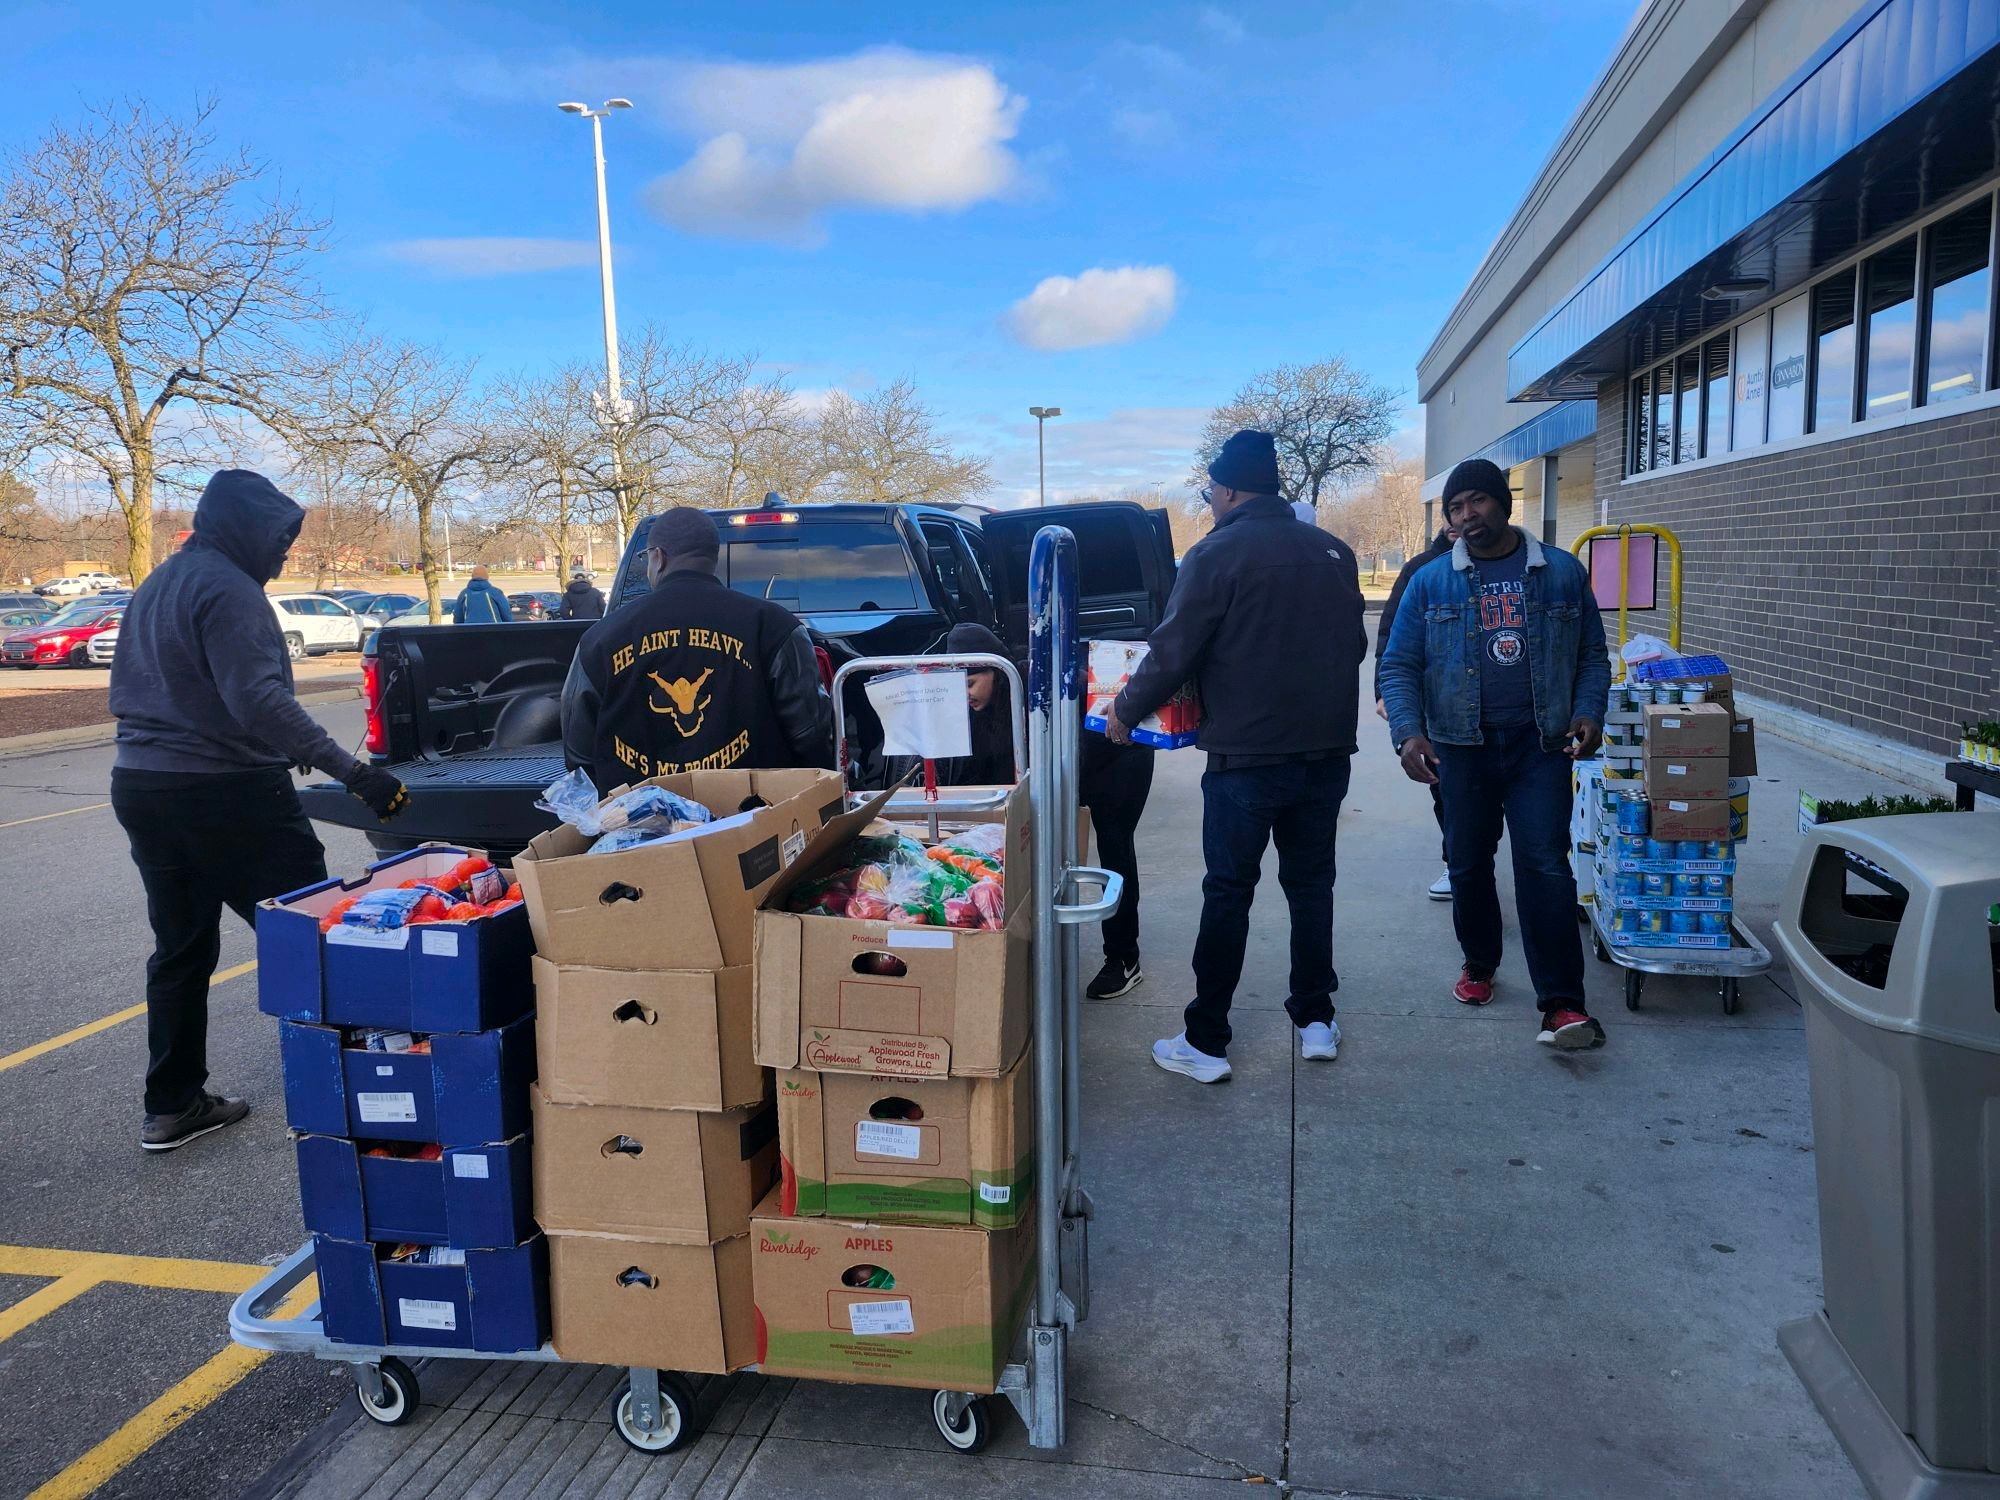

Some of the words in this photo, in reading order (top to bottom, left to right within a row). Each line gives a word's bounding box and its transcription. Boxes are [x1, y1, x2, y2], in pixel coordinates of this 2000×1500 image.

[1481, 581, 1523, 596] ETRO
[1481, 592, 1524, 630] GE
[612, 643, 635, 676] HE
[639, 629, 681, 656] AINT
[688, 628, 752, 670] HEAVY...
[614, 734, 649, 775] HE'S
[656, 760, 679, 777] MY
[852, 935, 884, 945] Produce
[881, 1039, 916, 1048] Distributed
[812, 1049, 862, 1064] Applewood
[868, 1046, 915, 1057] Applewood
[917, 1051, 940, 1060] Fresh
[876, 1056, 913, 1068] Growers,
[915, 1061, 932, 1069] LLC
[760, 1238, 819, 1260] Riveridge
[844, 1237, 893, 1252] APPLES
